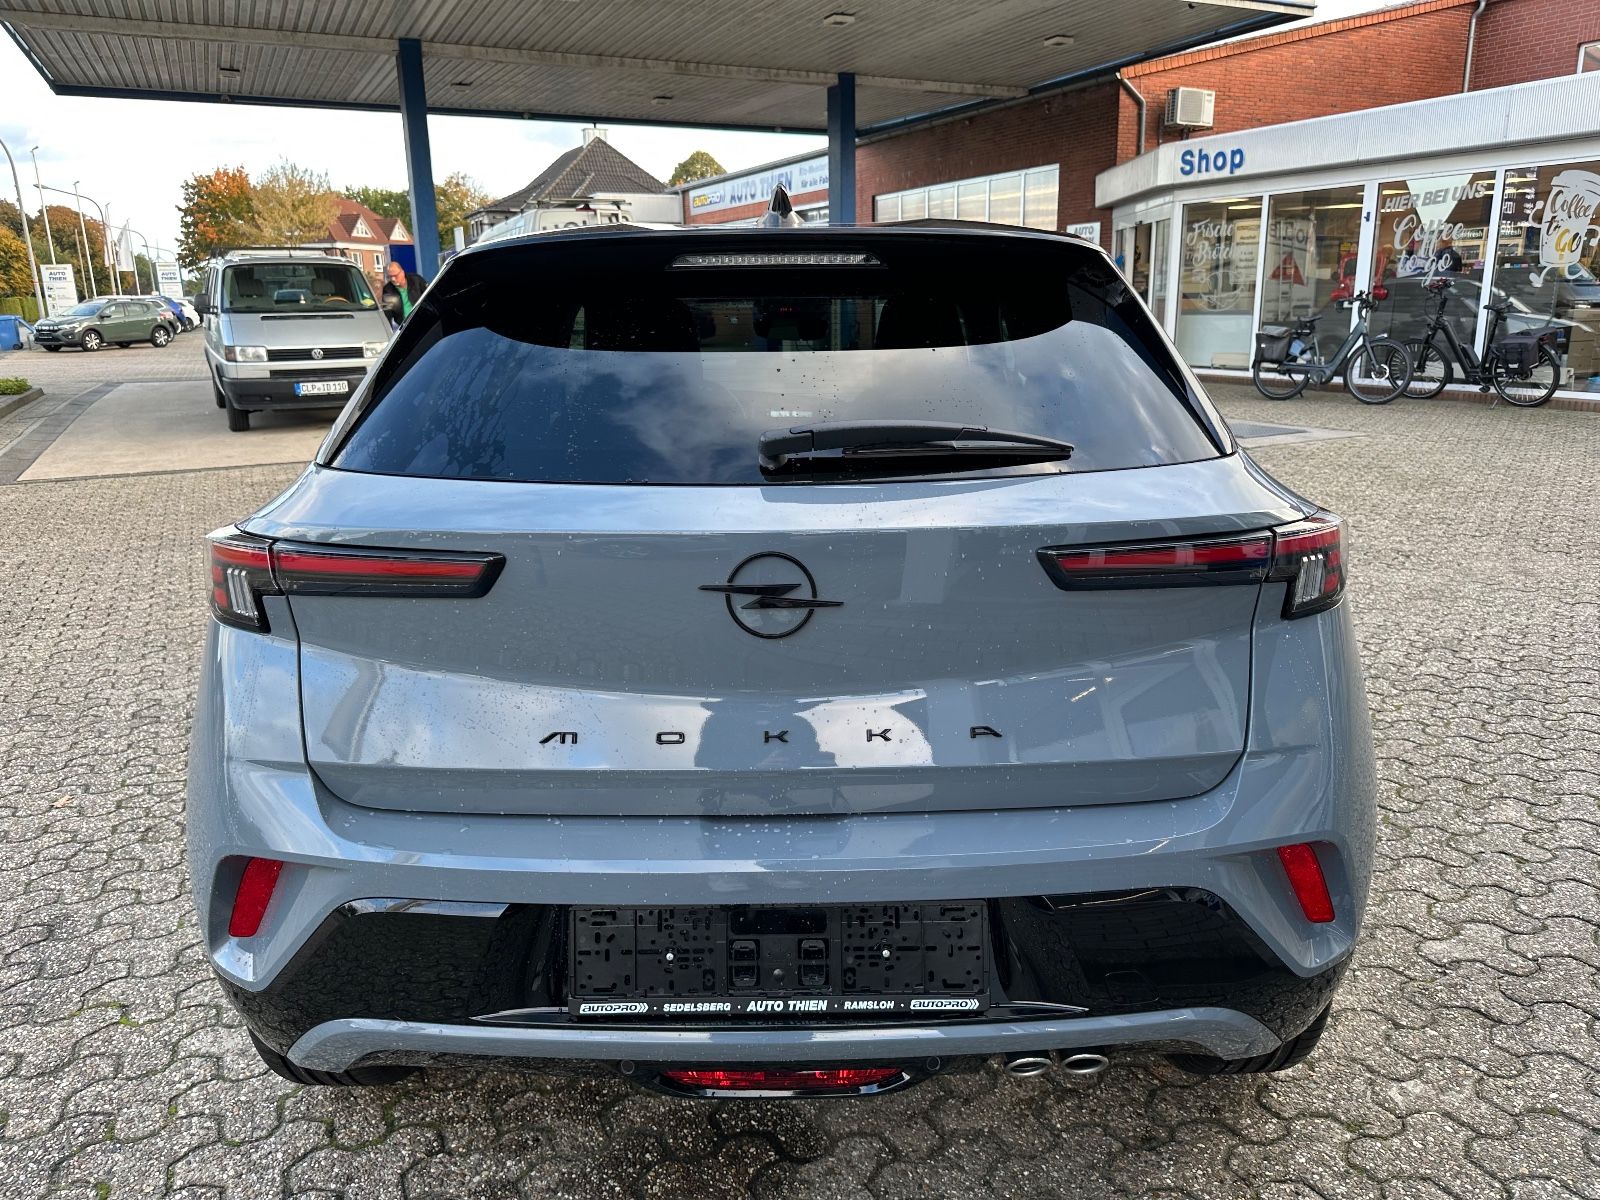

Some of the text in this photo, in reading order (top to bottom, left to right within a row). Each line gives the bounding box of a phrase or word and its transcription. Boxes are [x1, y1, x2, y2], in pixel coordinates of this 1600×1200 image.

[1180, 147, 1245, 175] Shop
[729, 180, 757, 204] AUTO
[1384, 181, 1488, 210] HIER BEI UNS
[1550, 189, 1592, 219] Coffee
[1074, 225, 1095, 236] AUTO
[1186, 217, 1234, 246] Frische
[1392, 213, 1464, 258] Coffee
[1422, 253, 1454, 288] go
[539, 725, 1002, 745] MOKKA
[662, 1002, 731, 1012] SEDELSBERG
[746, 999, 784, 1012] AUTO
[788, 999, 828, 1012] THIEN
[843, 1000, 895, 1010] RAMSLOH
